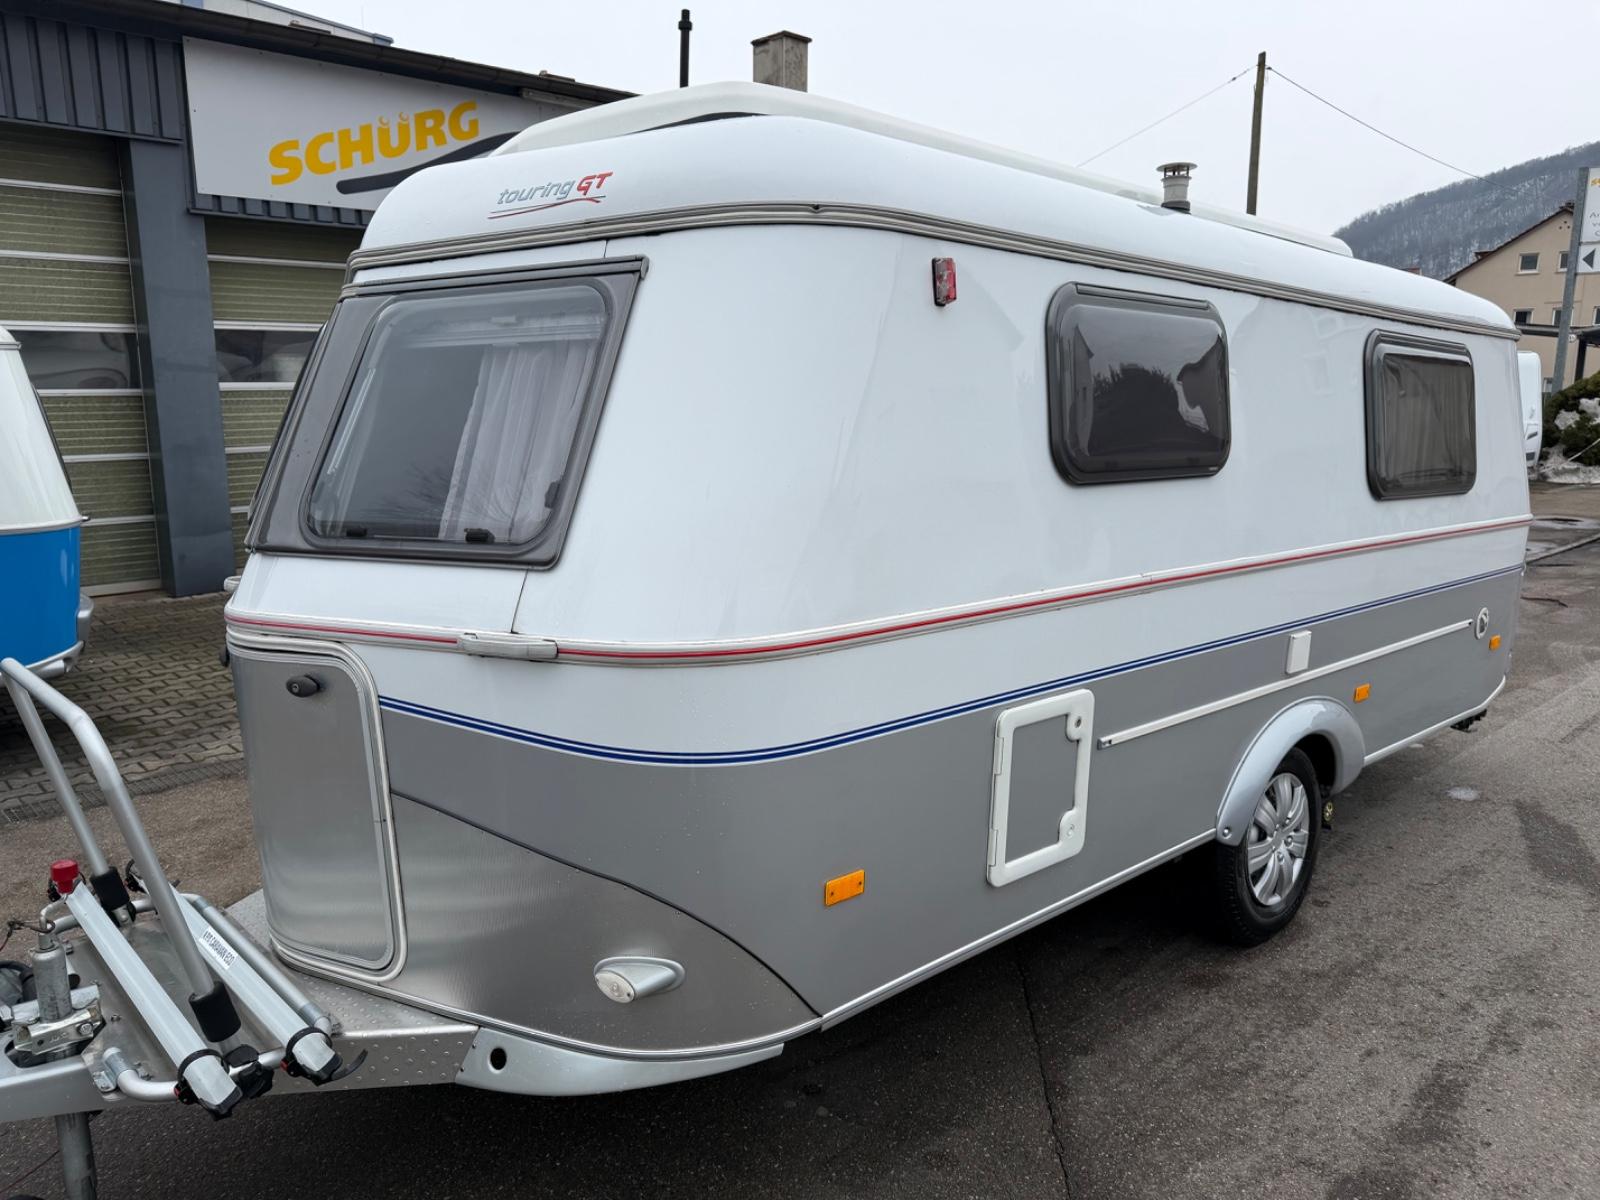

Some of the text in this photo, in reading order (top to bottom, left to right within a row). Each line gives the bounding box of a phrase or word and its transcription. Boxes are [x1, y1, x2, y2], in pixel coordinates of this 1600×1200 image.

[268, 101, 480, 186] SCHÜRG
[497, 171, 613, 205] touring GT
